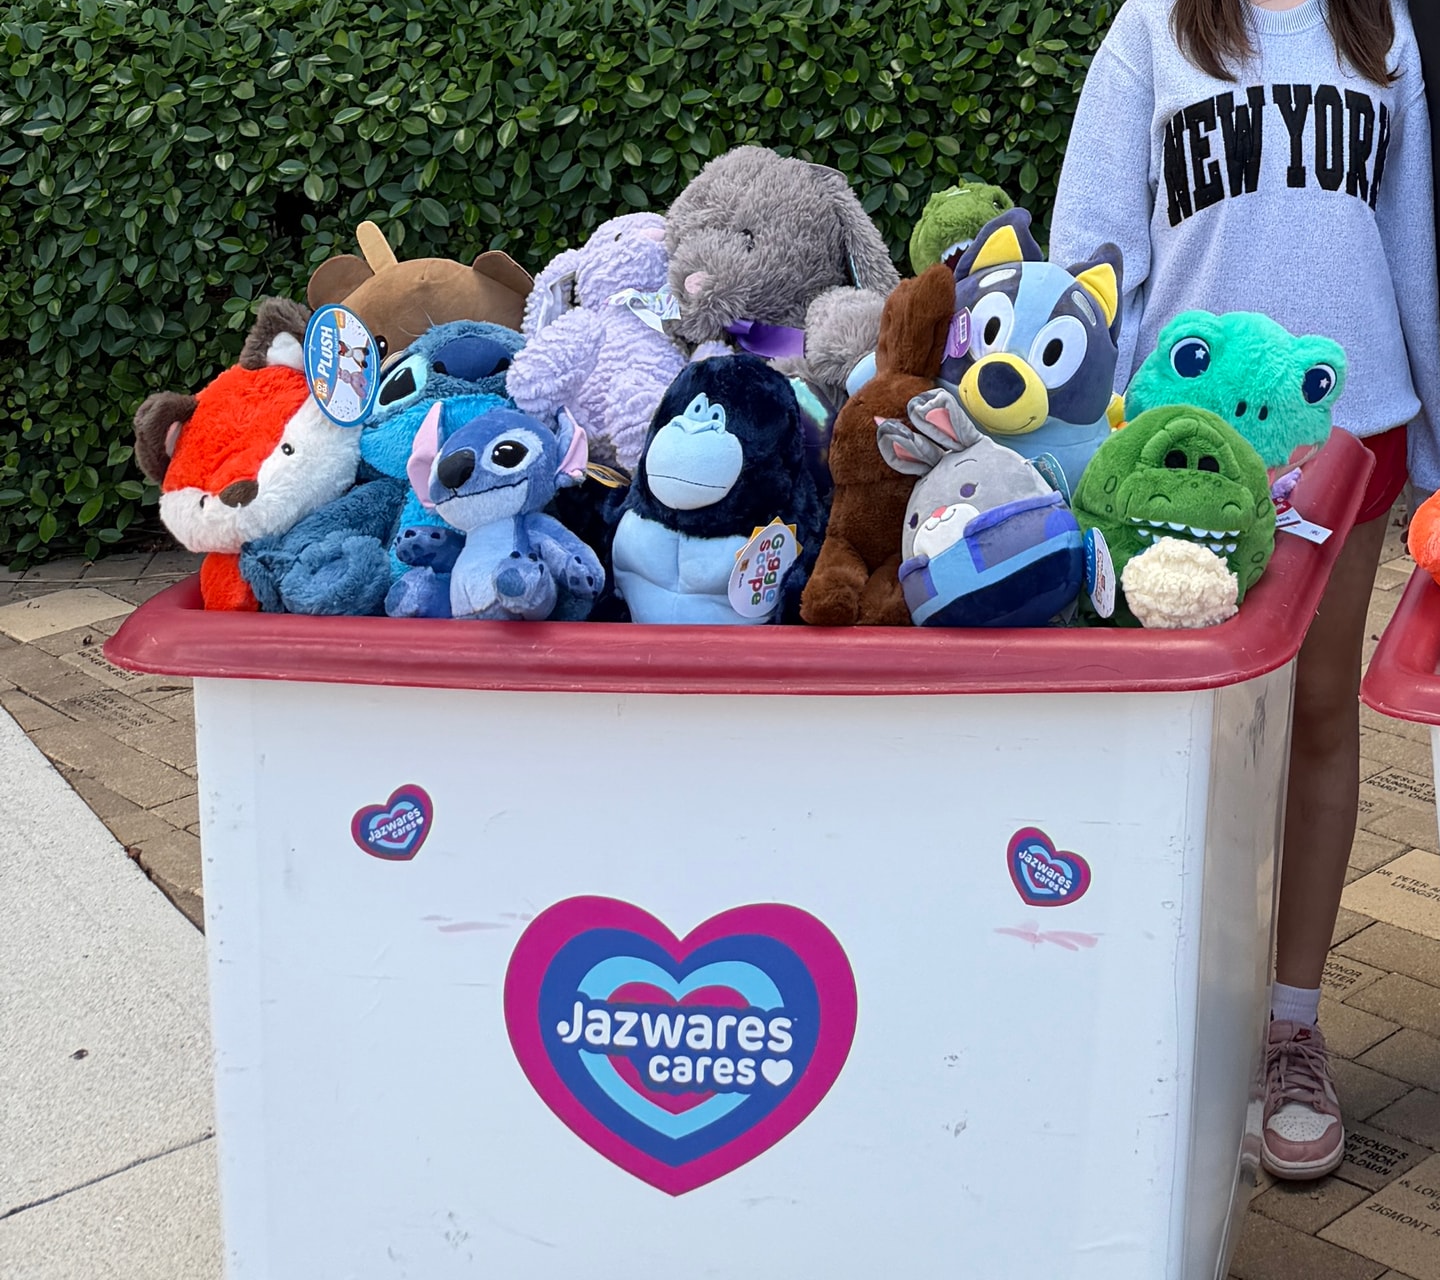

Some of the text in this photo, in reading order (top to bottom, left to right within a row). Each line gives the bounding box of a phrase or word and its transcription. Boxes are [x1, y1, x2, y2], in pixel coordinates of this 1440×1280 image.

[1163, 85, 1266, 228] NEW
[317, 325, 333, 378] PLUSH
[763, 533, 785, 602] Giggle
[368, 807, 421, 843] Jazwares
[392, 820, 417, 839] cares
[1018, 850, 1072, 889] Jazwares
[1034, 871, 1060, 892] cares
[1396, 875, 1430, 889] PETER
[557, 1001, 793, 1053] Jazwares
[649, 1055, 757, 1086] cares
[1349, 1132, 1409, 1160] BECKER'S
[1366, 1202, 1433, 1233] ZIGMONT
